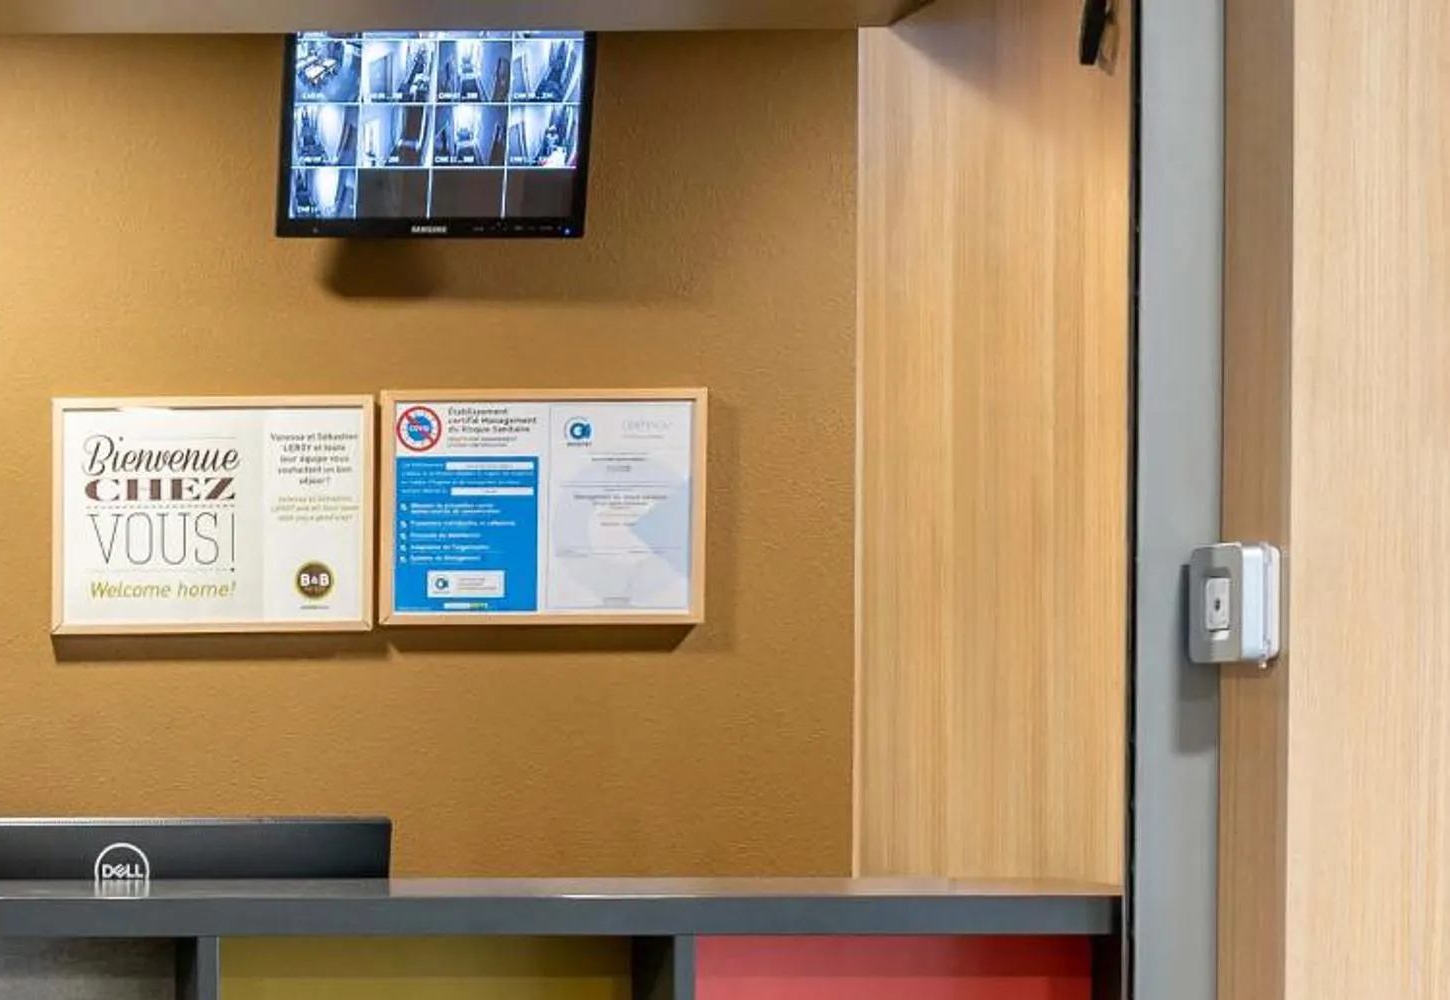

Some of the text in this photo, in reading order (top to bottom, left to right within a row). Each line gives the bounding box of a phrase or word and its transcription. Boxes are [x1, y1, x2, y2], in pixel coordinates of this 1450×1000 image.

[411, 225, 447, 233] SAMSUNG
[481, 417, 537, 426] Management
[82, 434, 241, 476] Bienvenue
[85, 477, 236, 501] CHEZ
[90, 581, 236, 599] Welcome home!
[102, 864, 144, 878] DELL
